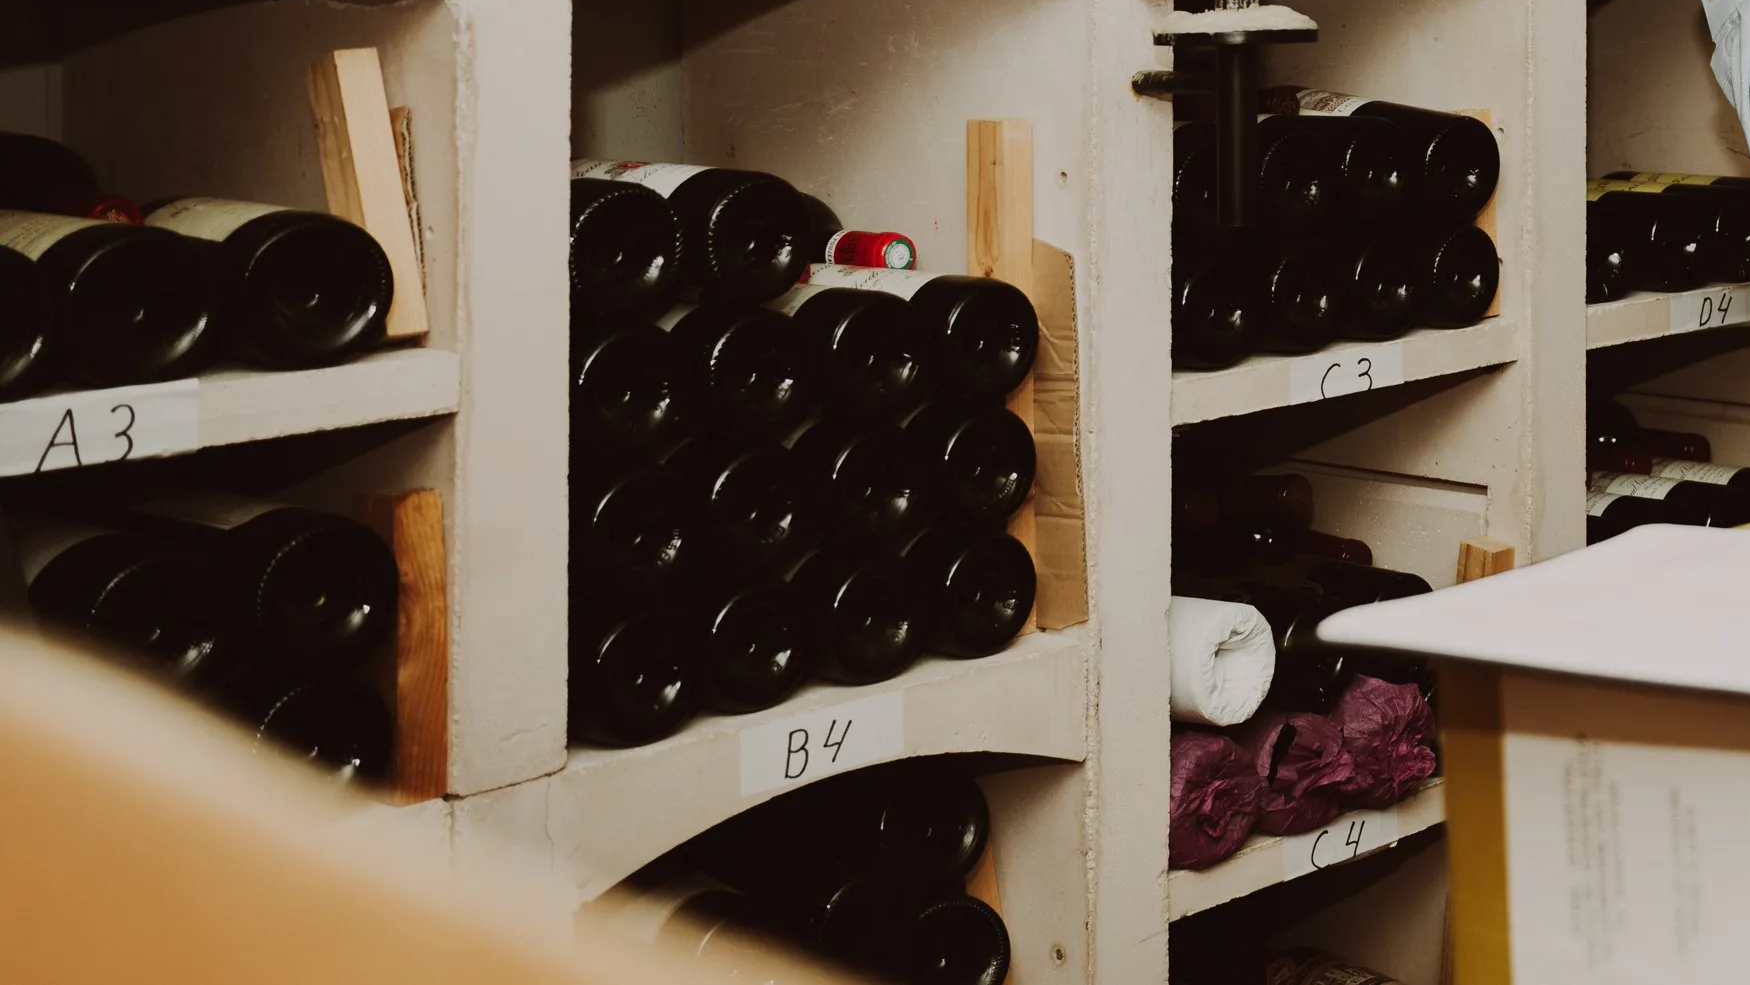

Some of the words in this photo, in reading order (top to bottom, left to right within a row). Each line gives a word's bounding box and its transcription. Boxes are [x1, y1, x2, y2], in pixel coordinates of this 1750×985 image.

[1698, 296, 1733, 326] D4
[1320, 357, 1373, 399] C3
[35, 404, 138, 475] A3
[784, 719, 852, 781] B4
[1311, 819, 1367, 870] C4
